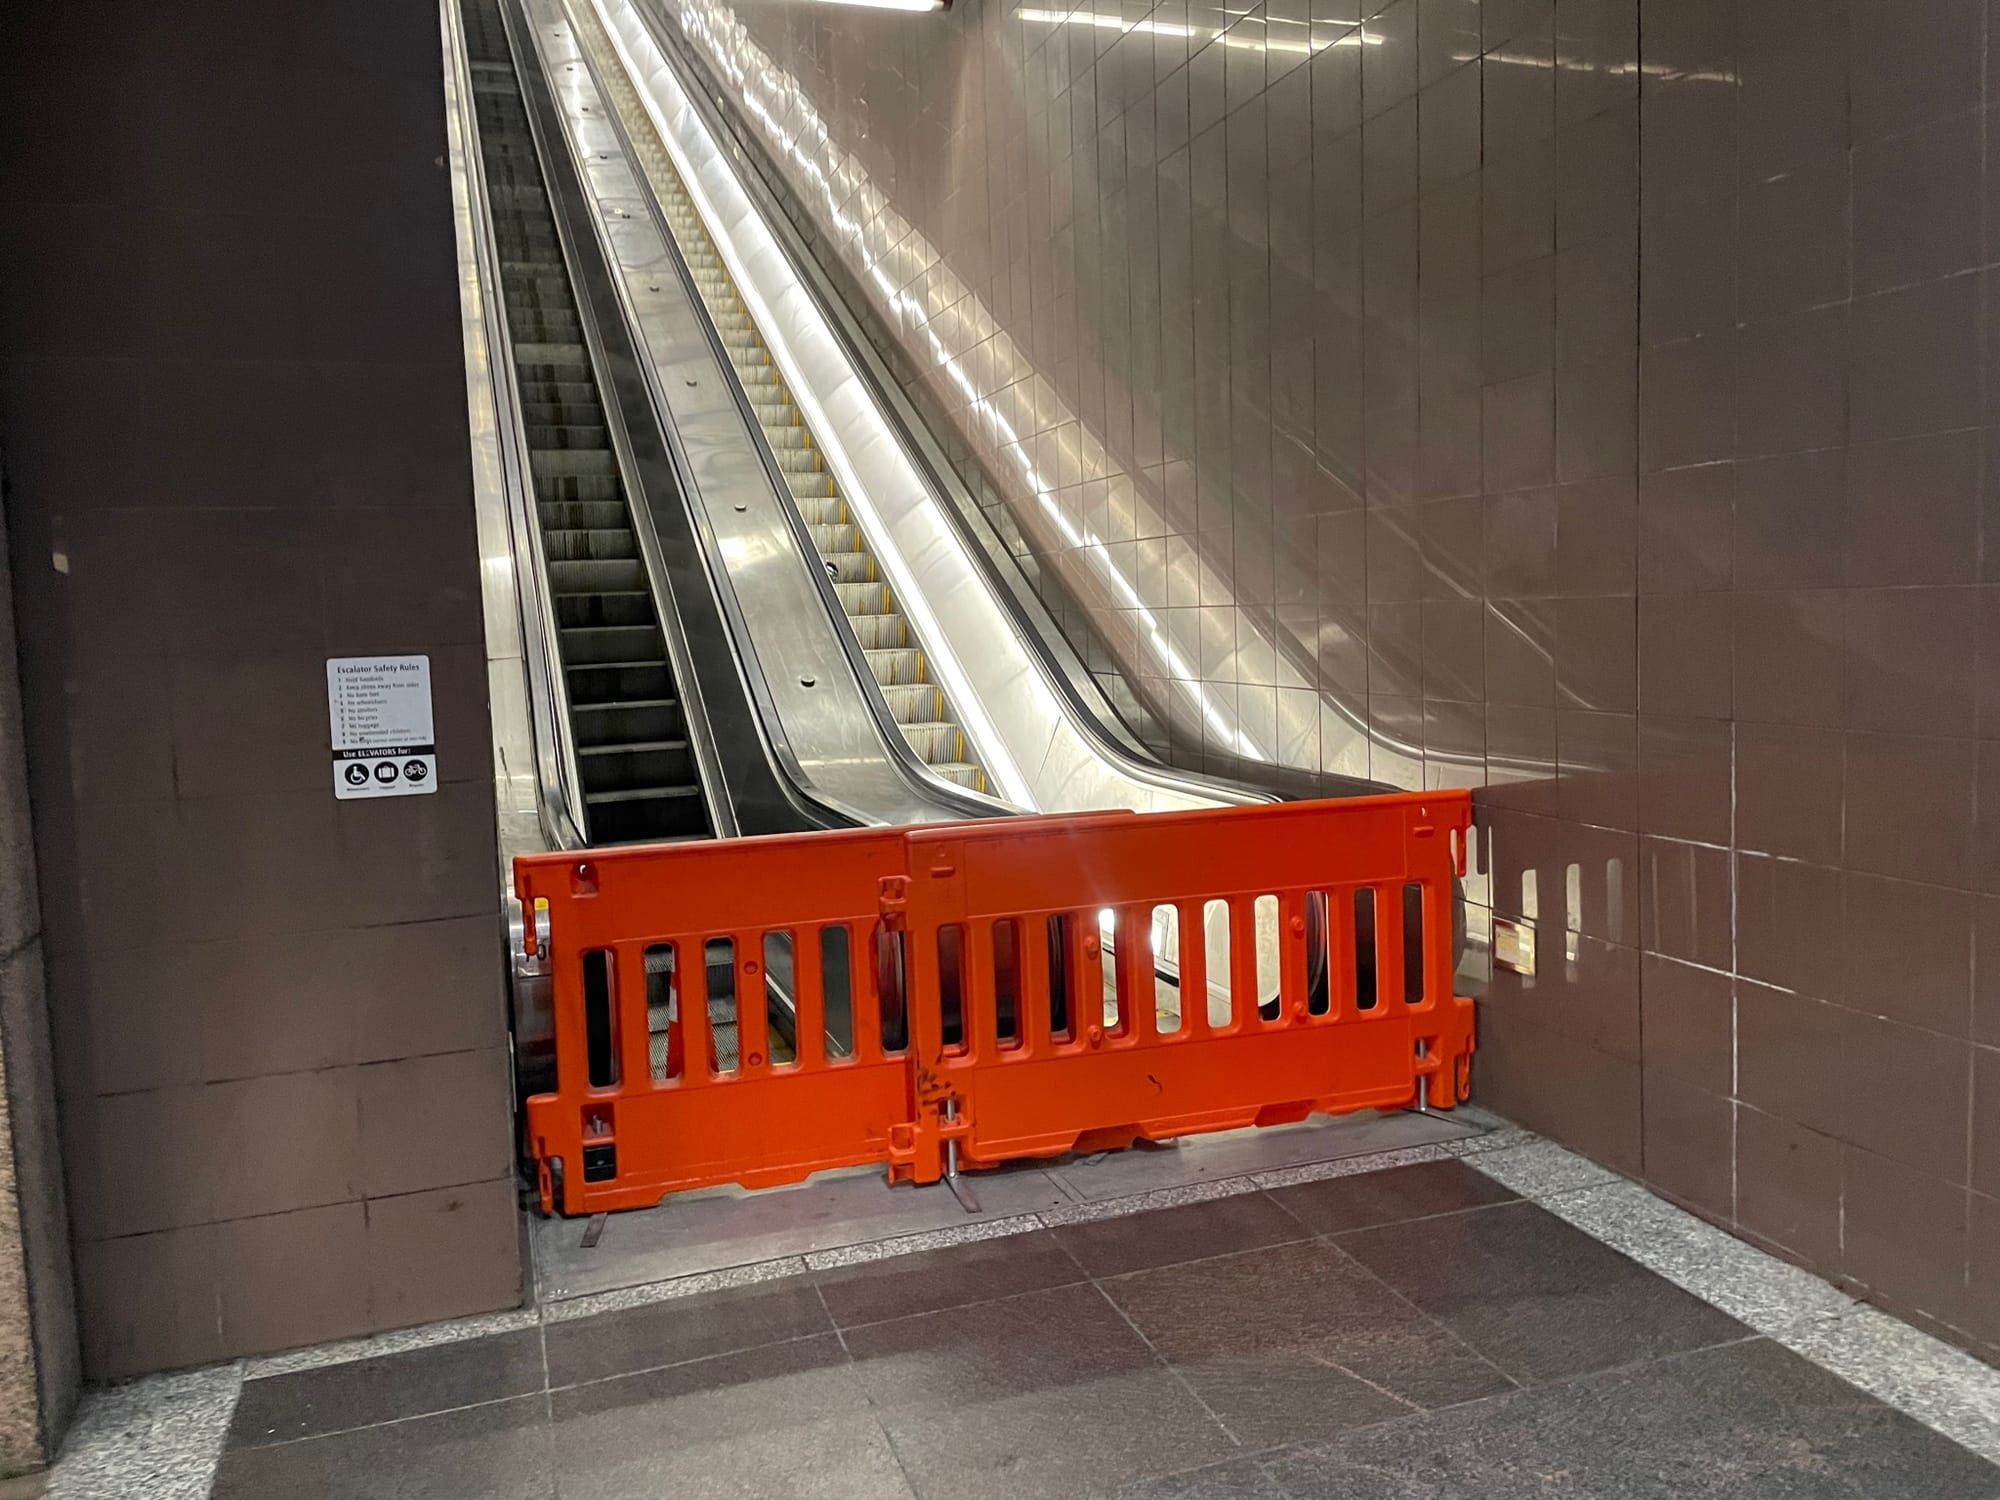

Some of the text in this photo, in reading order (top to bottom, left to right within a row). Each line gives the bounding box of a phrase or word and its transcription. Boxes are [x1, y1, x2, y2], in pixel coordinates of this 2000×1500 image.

[338, 665, 371, 673] Escalator
[374, 664, 397, 673] Safety
[358, 748, 396, 757] ELEVATORS
